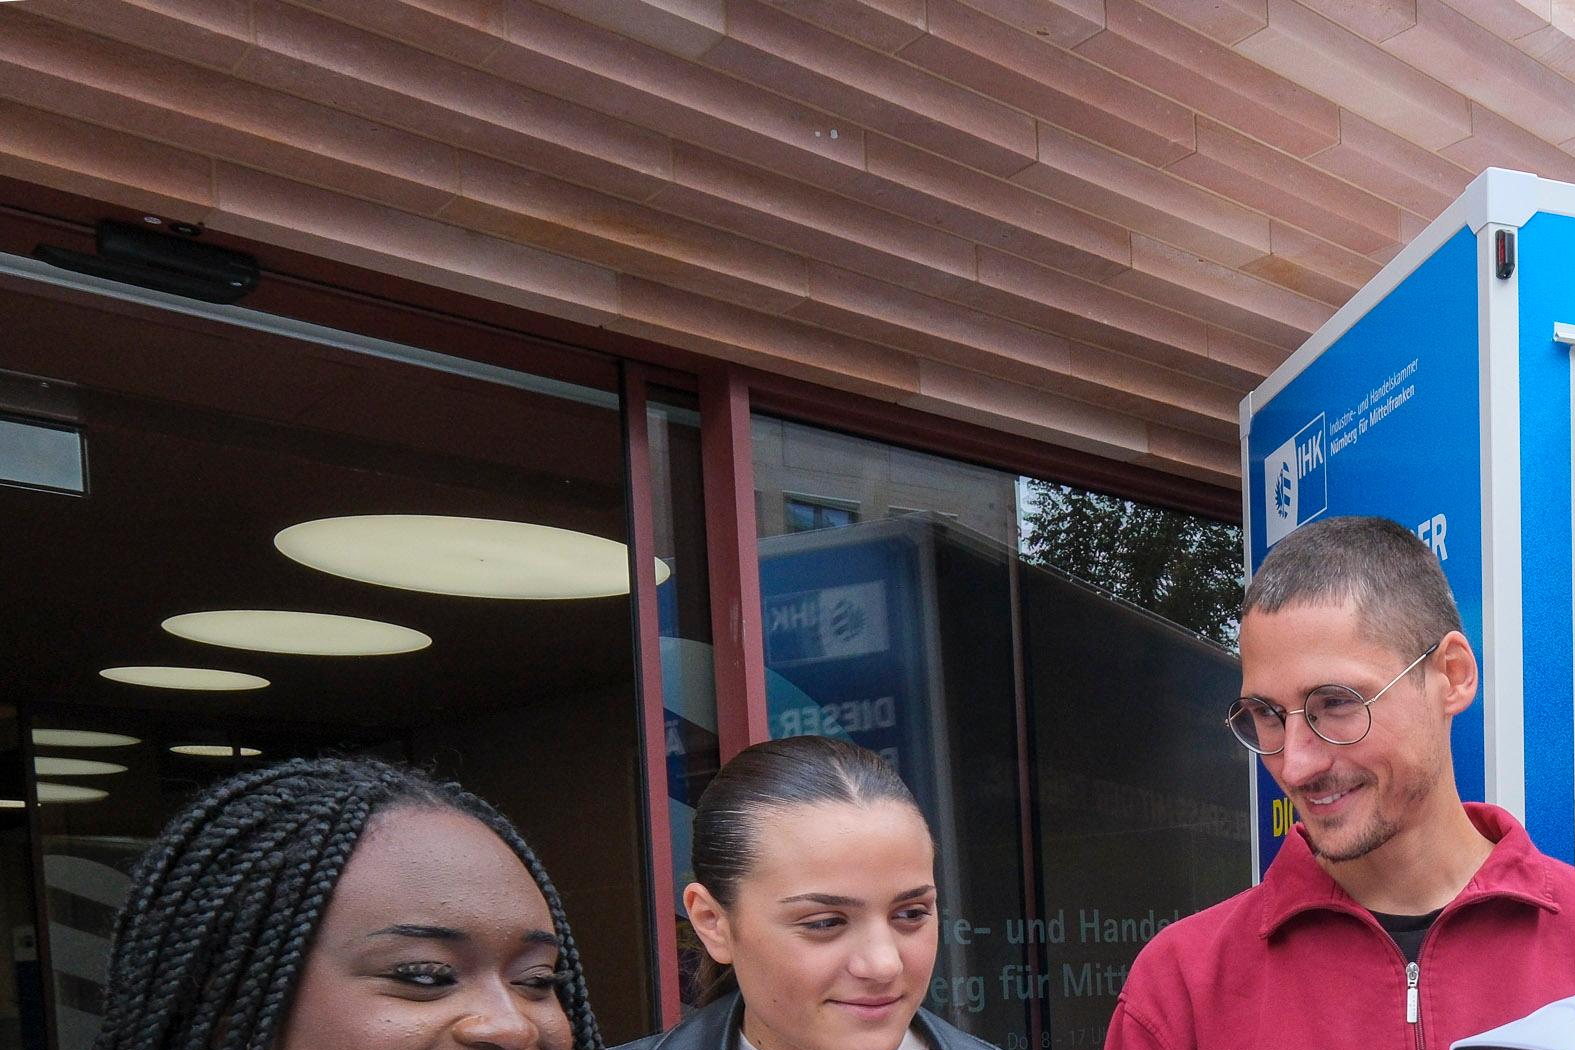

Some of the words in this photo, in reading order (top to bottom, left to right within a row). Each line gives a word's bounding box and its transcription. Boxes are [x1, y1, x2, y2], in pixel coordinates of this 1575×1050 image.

[1329, 408, 1357, 436] Industrie-
[1358, 393, 1369, 415] und
[1370, 358, 1419, 405] Handelskammer
[1330, 427, 1358, 456] Nürnberg
[1358, 417, 1368, 435] für
[1369, 384, 1415, 427] Mittelfranken
[1297, 430, 1324, 480] IHK
[1410, 513, 1448, 561] ER
[943, 911, 991, 945] ie-
[1006, 909, 1065, 944] und
[931, 975, 986, 1013] erg
[1000, 964, 1049, 1000] für
[1063, 963, 1128, 998] Mitt
